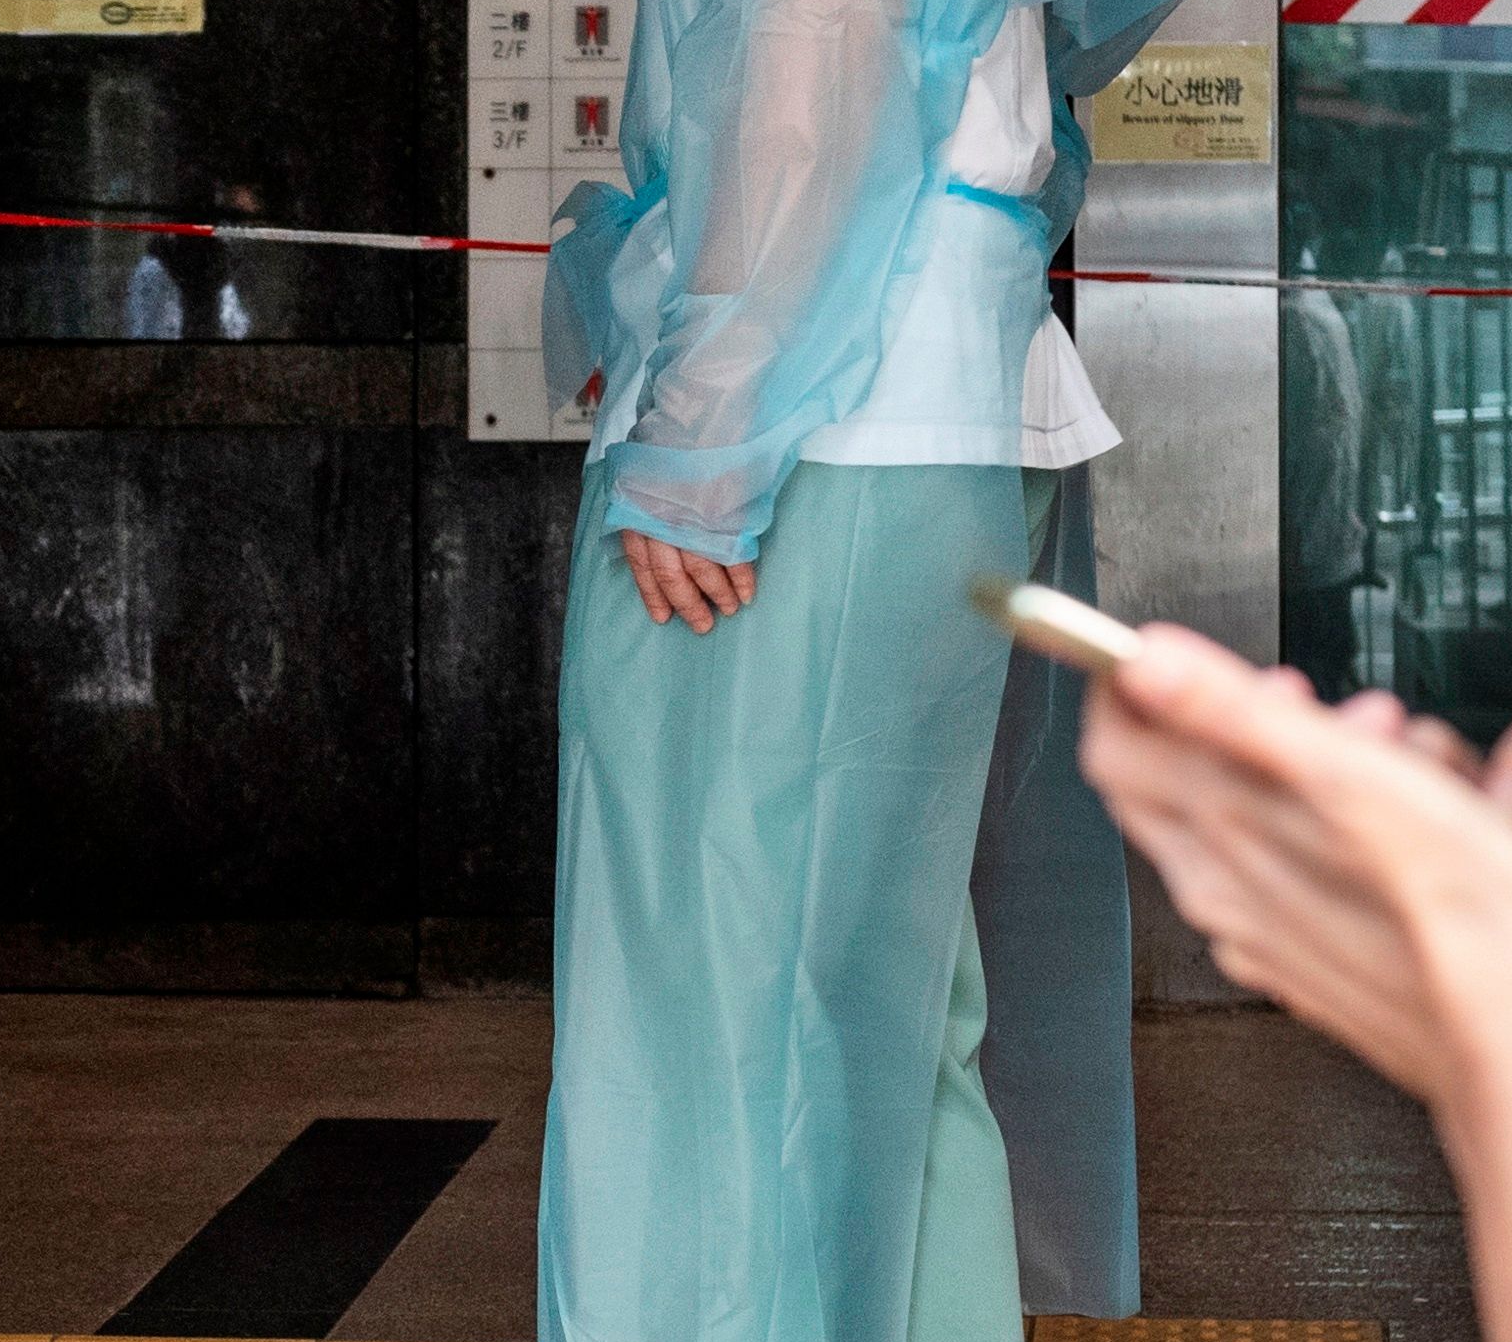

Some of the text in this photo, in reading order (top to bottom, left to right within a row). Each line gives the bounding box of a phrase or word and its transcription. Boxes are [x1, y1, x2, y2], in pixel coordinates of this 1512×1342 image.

[489, 11, 530, 32] 二樓
[492, 40, 528, 59] 2/F
[1125, 75, 1244, 107] 小心地滑
[489, 101, 529, 122] 三樓
[492, 130, 528, 149] 3/F
